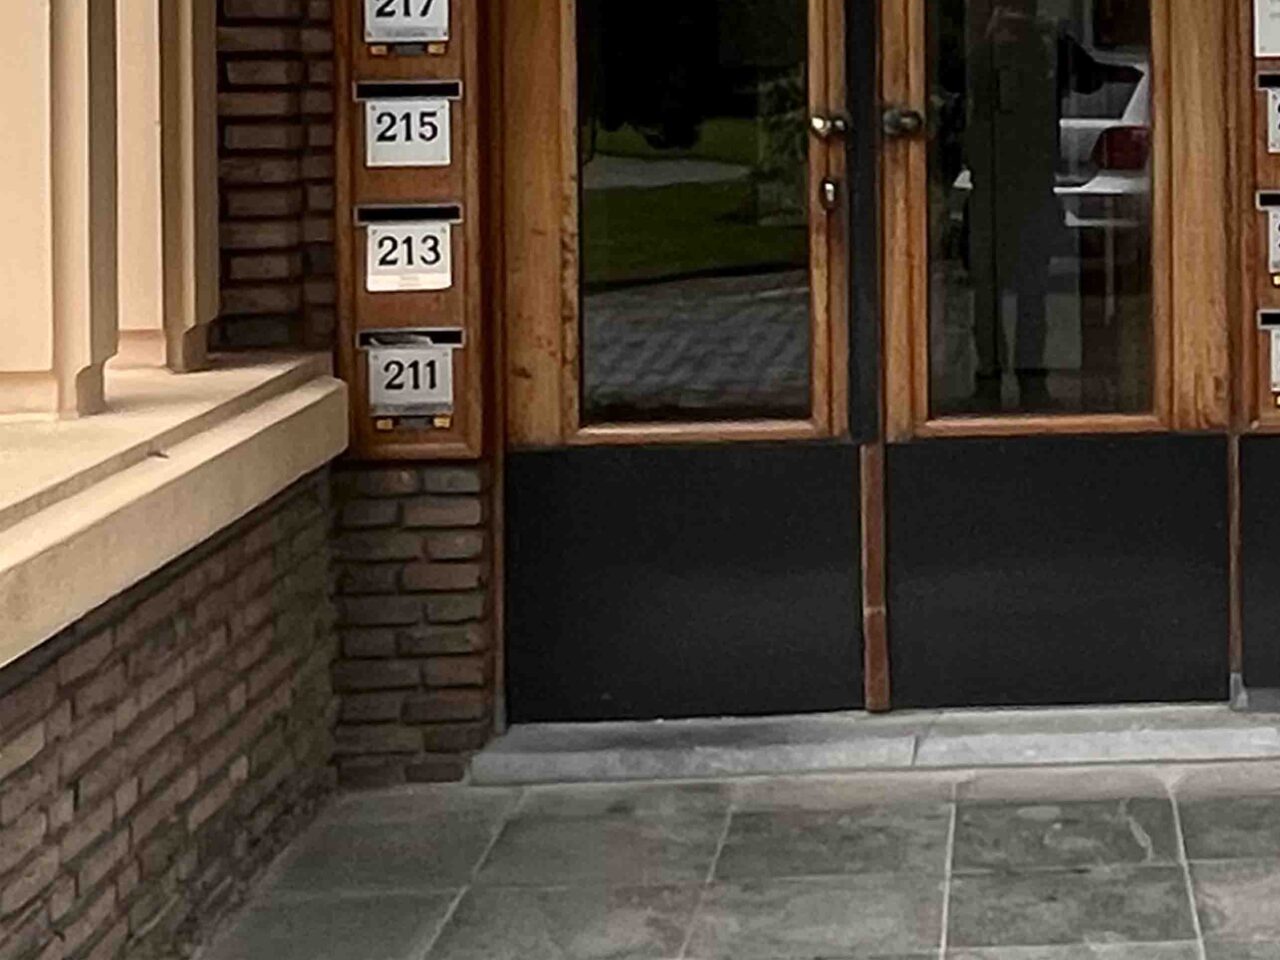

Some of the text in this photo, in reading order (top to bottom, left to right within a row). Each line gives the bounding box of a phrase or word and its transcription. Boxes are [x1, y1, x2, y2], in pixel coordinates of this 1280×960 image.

[376, 111, 438, 143] 215
[378, 235, 441, 266] 213
[383, 359, 437, 391] 211
